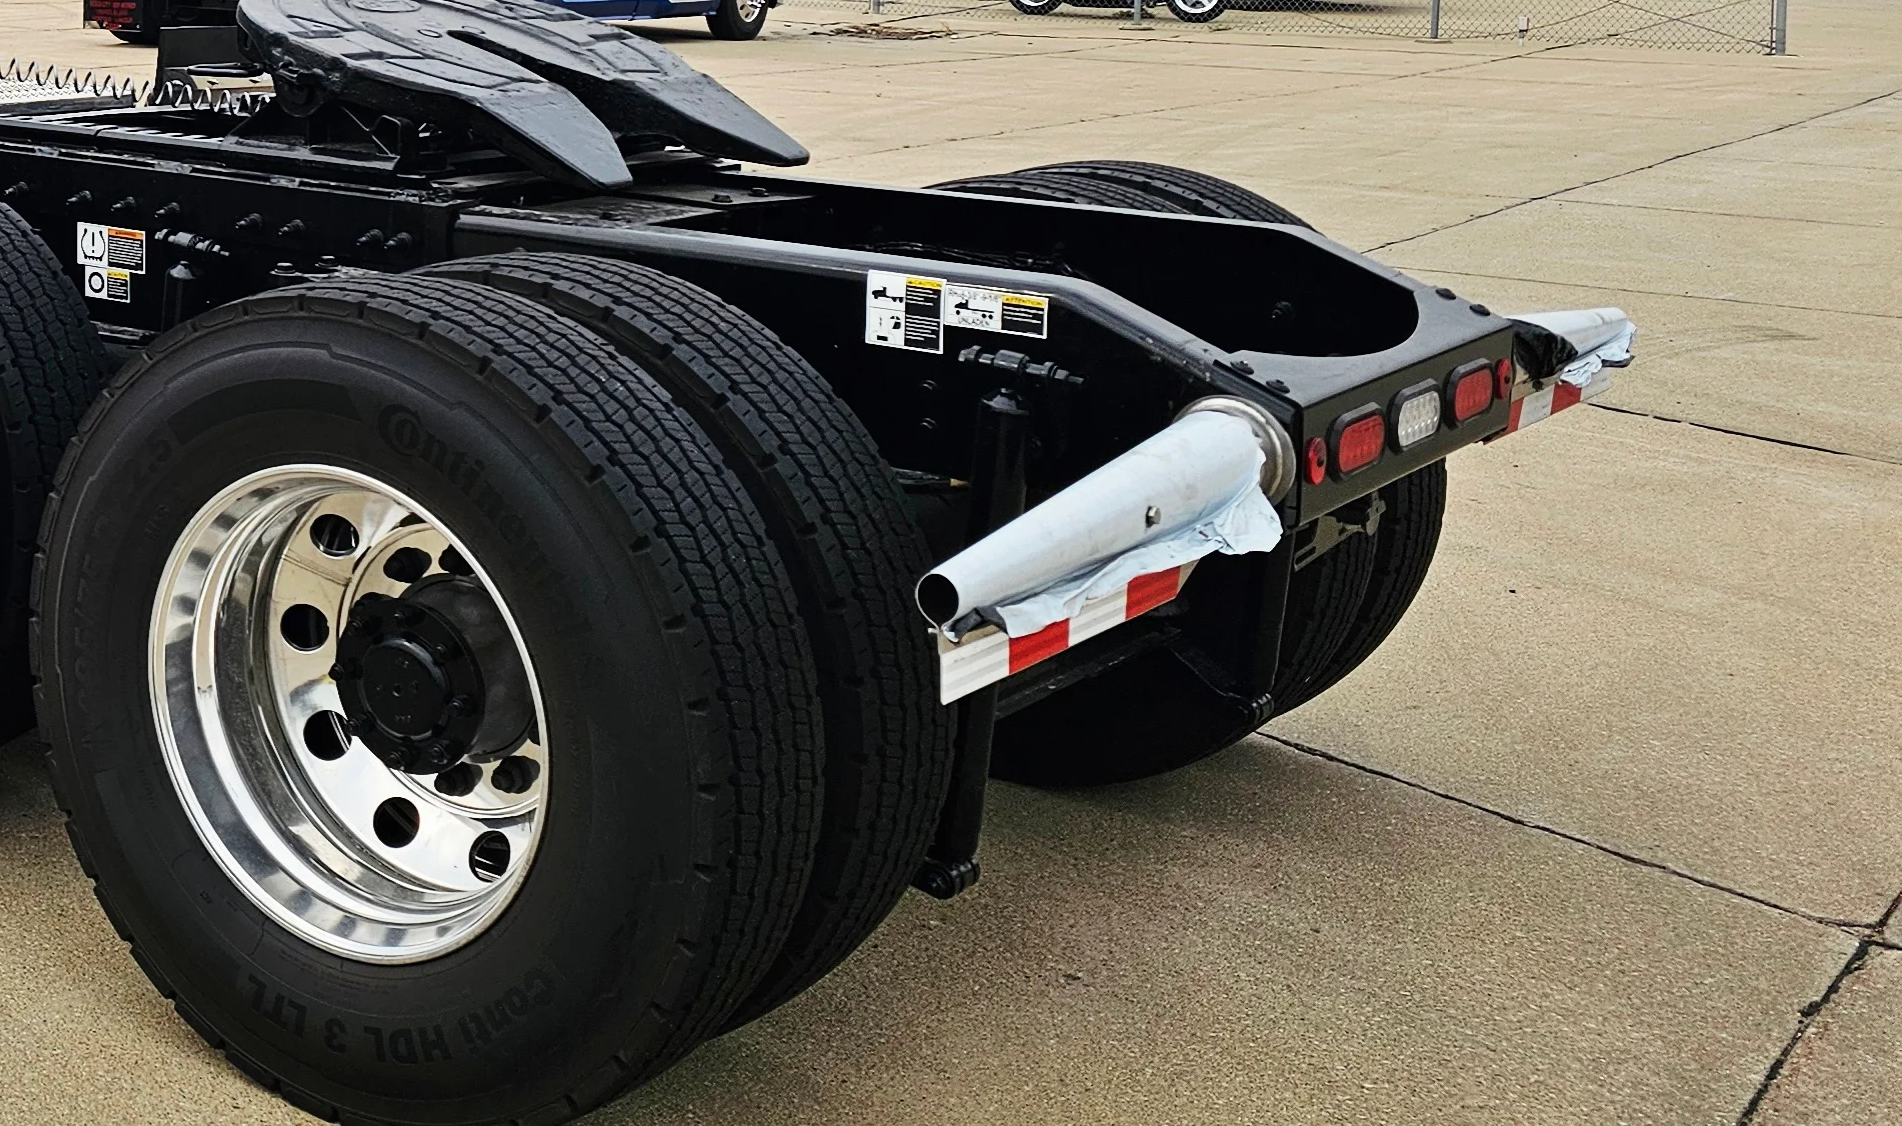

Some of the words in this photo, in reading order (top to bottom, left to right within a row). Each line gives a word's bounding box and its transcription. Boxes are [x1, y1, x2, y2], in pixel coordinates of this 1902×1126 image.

[248, 972, 308, 1039] LTL
[458, 967, 557, 1055] Conti
[325, 1017, 348, 1054] 3
[364, 1024, 454, 1064] HDL
